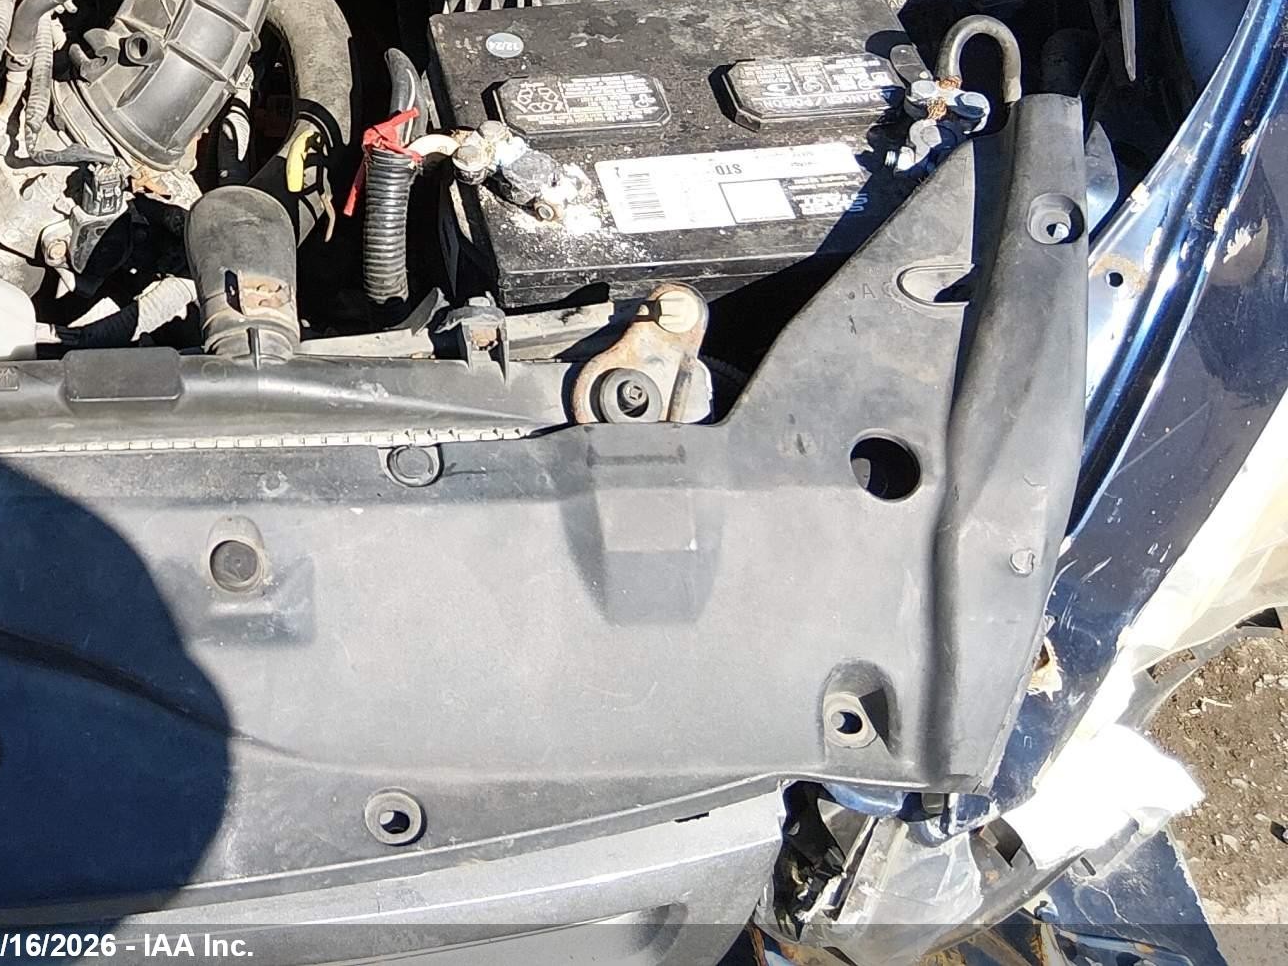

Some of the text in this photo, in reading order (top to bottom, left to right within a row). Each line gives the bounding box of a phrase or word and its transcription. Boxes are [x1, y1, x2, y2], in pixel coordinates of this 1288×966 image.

[762, 96, 810, 109] POISON
[826, 92, 879, 104] DANGER
[714, 164, 742, 174] STD
